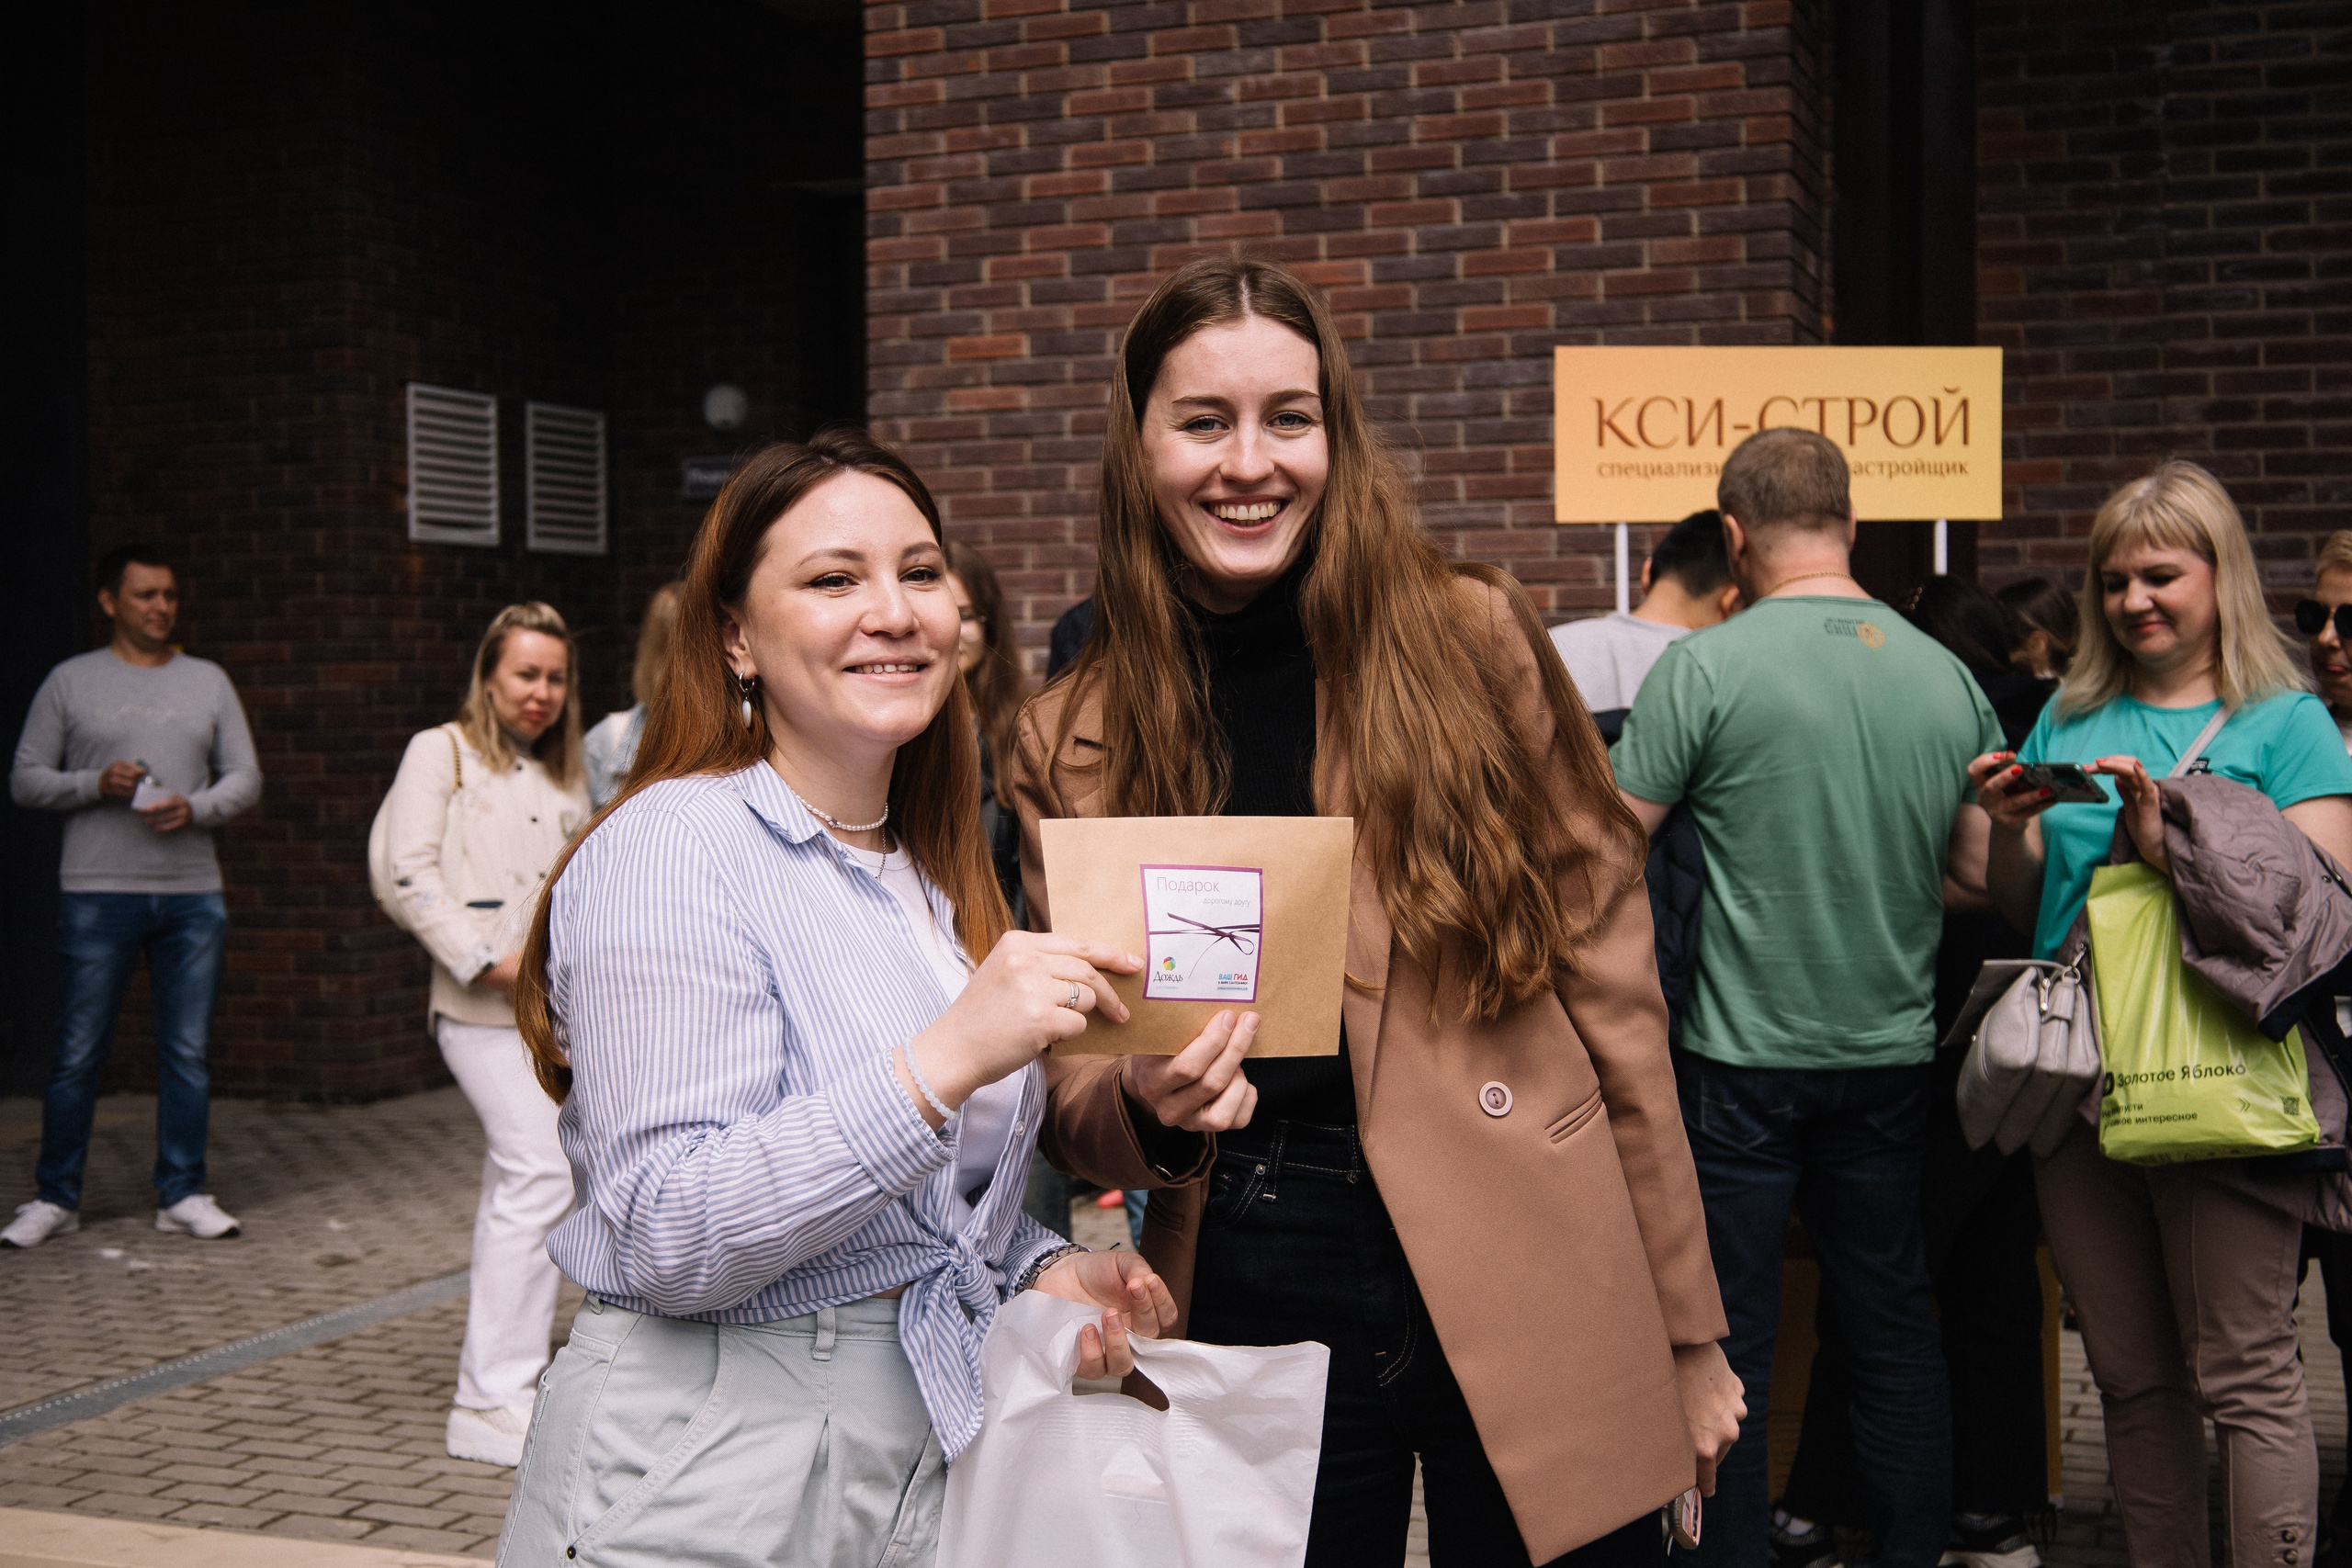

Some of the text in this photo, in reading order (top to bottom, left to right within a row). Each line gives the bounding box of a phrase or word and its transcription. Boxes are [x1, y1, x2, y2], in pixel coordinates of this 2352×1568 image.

[1590, 385, 1971, 449] КСИ-СТРОЙ
[1598, 457, 1969, 481] специализи астройщик
[1157, 877, 1219, 895] Подарок
[1153, 971, 1183, 983] Дождь
[2118, 1064, 2246, 1088] Золотое Яблоко
[2134, 1111, 2199, 1125] интересное
